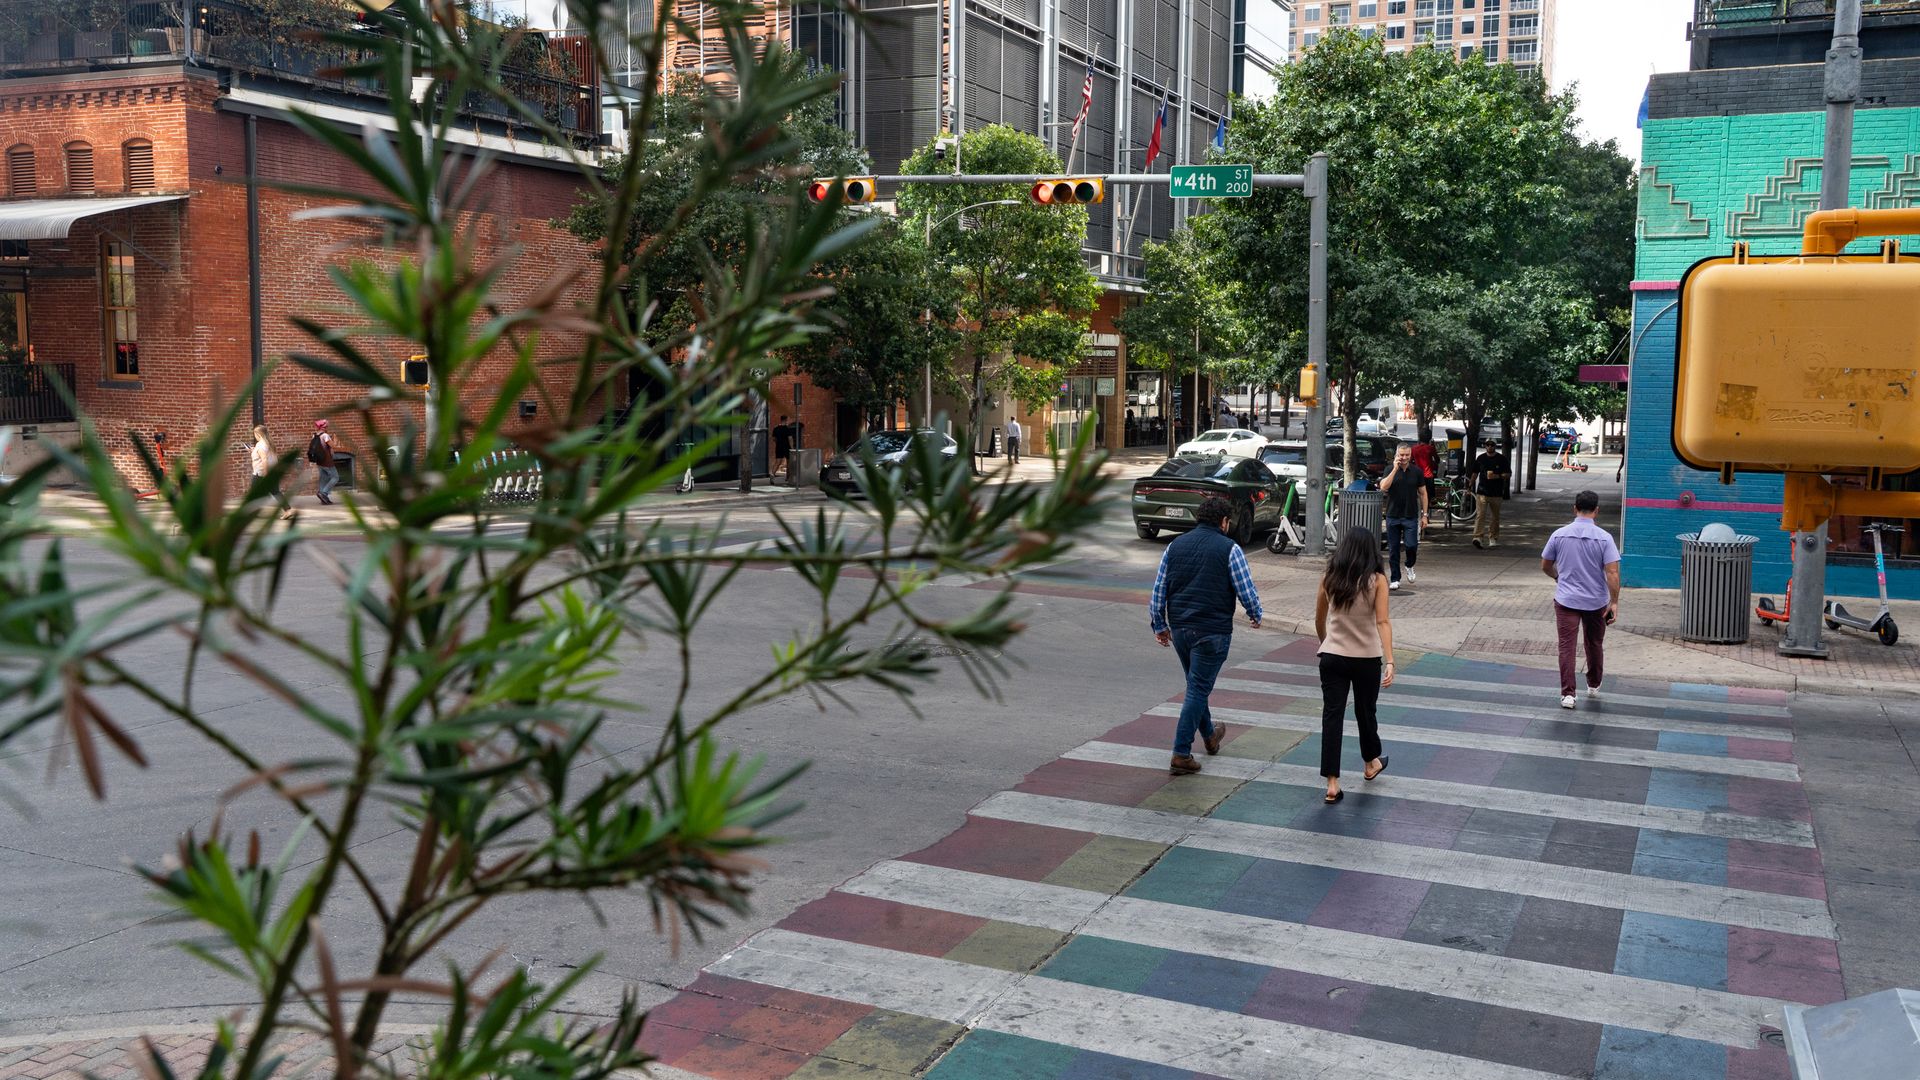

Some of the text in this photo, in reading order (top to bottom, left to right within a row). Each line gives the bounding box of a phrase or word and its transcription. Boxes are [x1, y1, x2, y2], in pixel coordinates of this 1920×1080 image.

[1174, 169, 1249, 191] W 4th ST
[1226, 182, 1249, 193] 200
